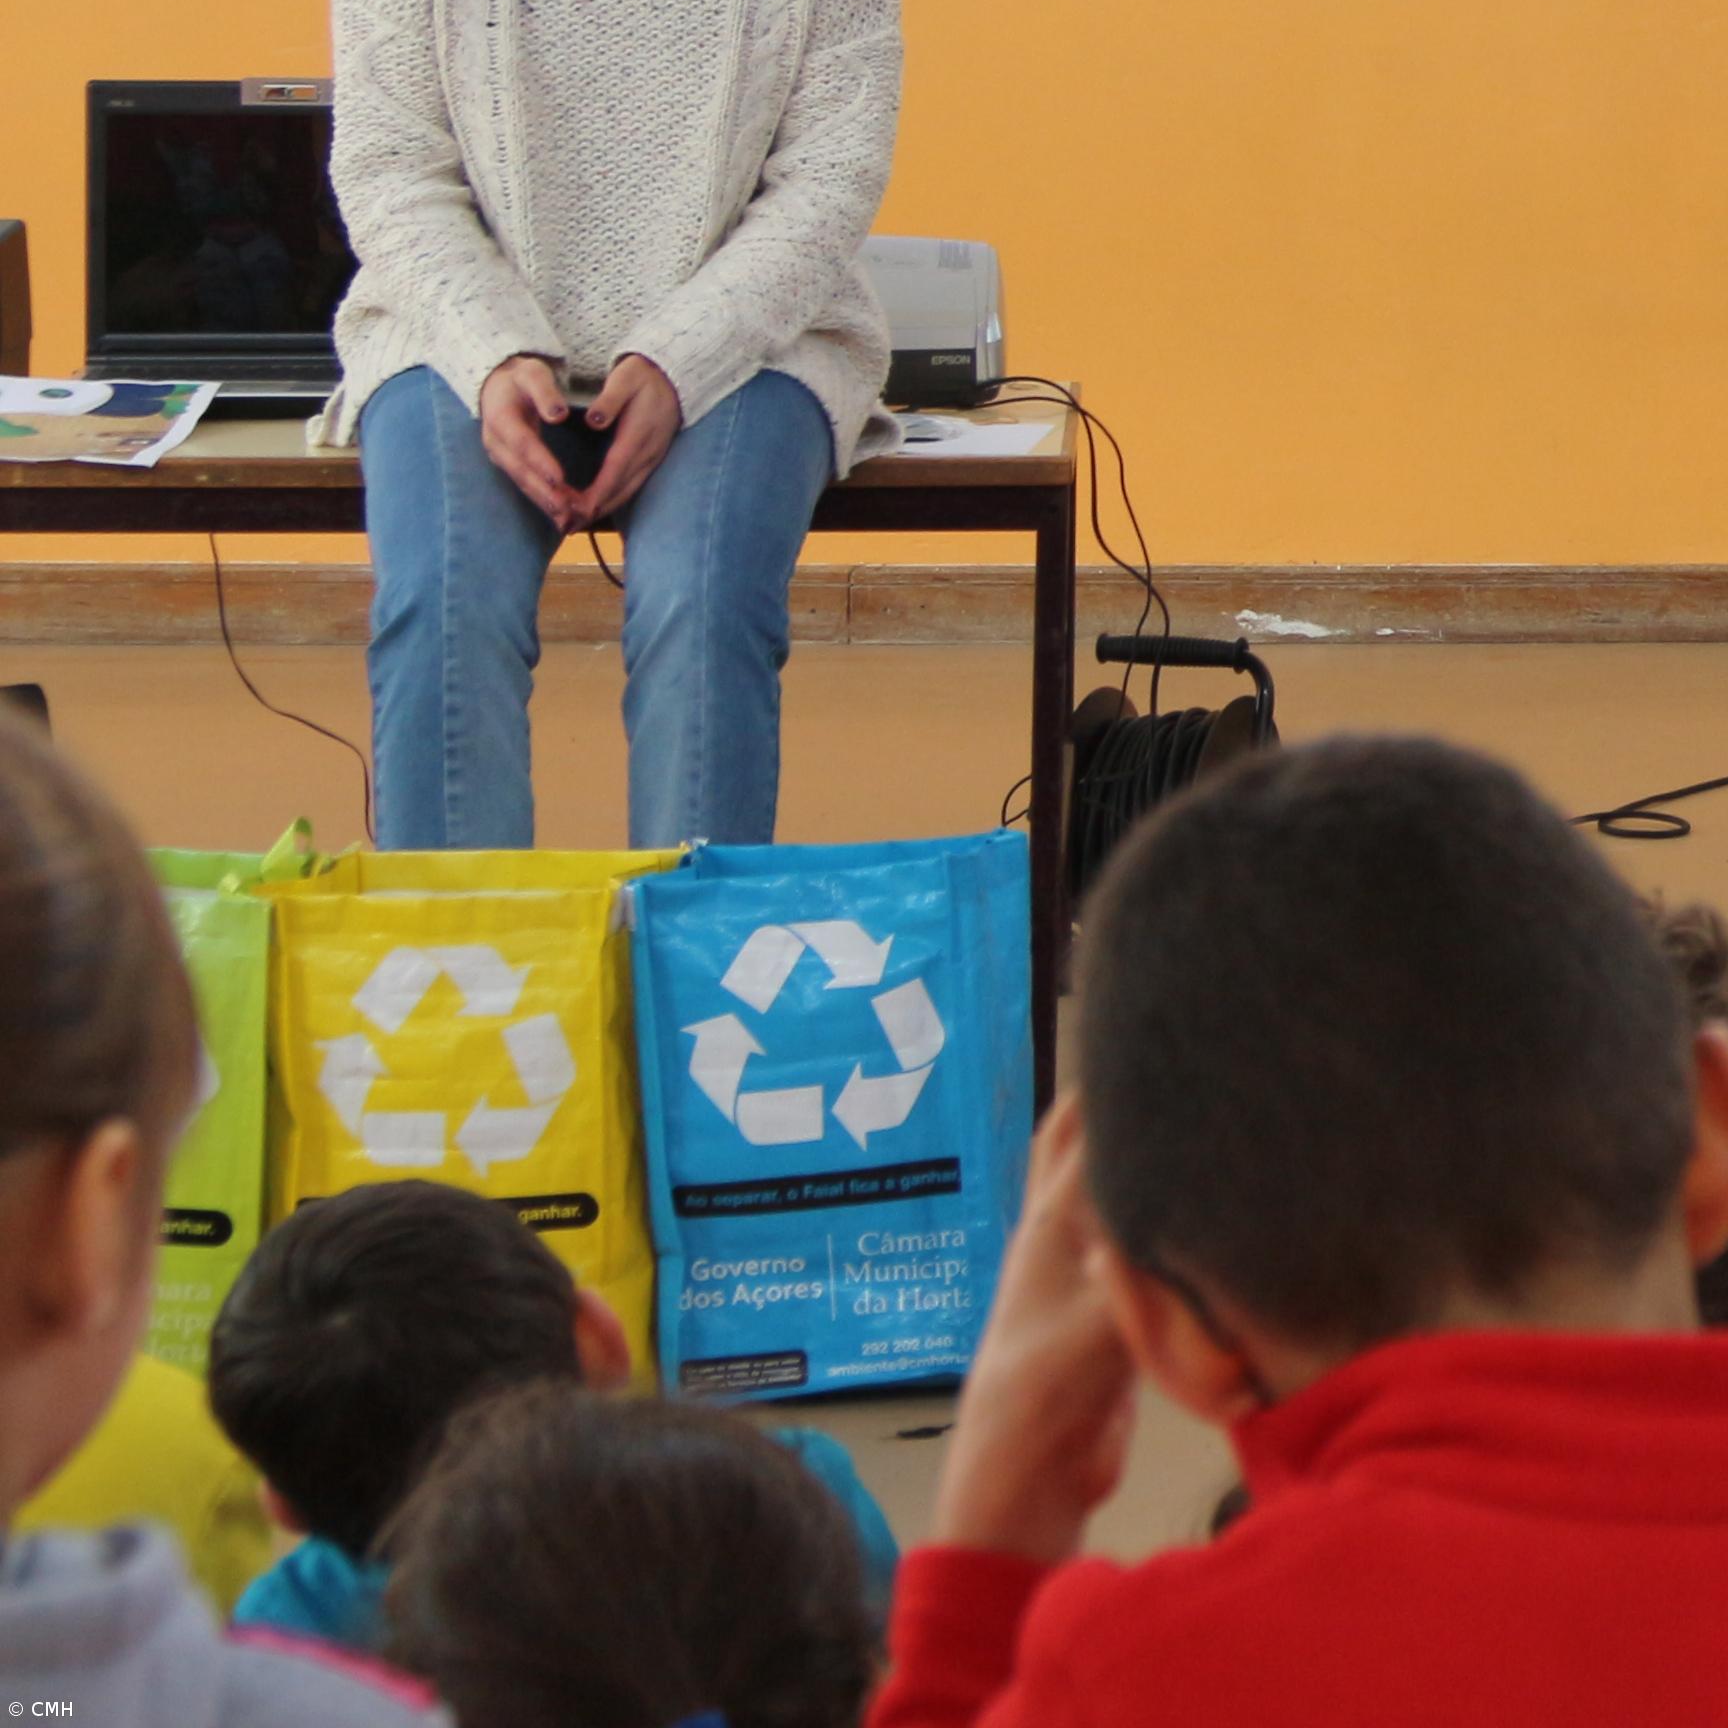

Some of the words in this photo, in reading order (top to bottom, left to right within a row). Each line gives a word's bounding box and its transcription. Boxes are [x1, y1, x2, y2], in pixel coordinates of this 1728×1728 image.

[931, 354, 971, 366] EPSON
[517, 1202, 582, 1226] ganhar.
[857, 1229, 966, 1257] Câmara
[691, 1256, 806, 1282] Governo
[678, 1286, 725, 1311] dos
[731, 1279, 824, 1312] Açores
[853, 1288, 888, 1316] da
